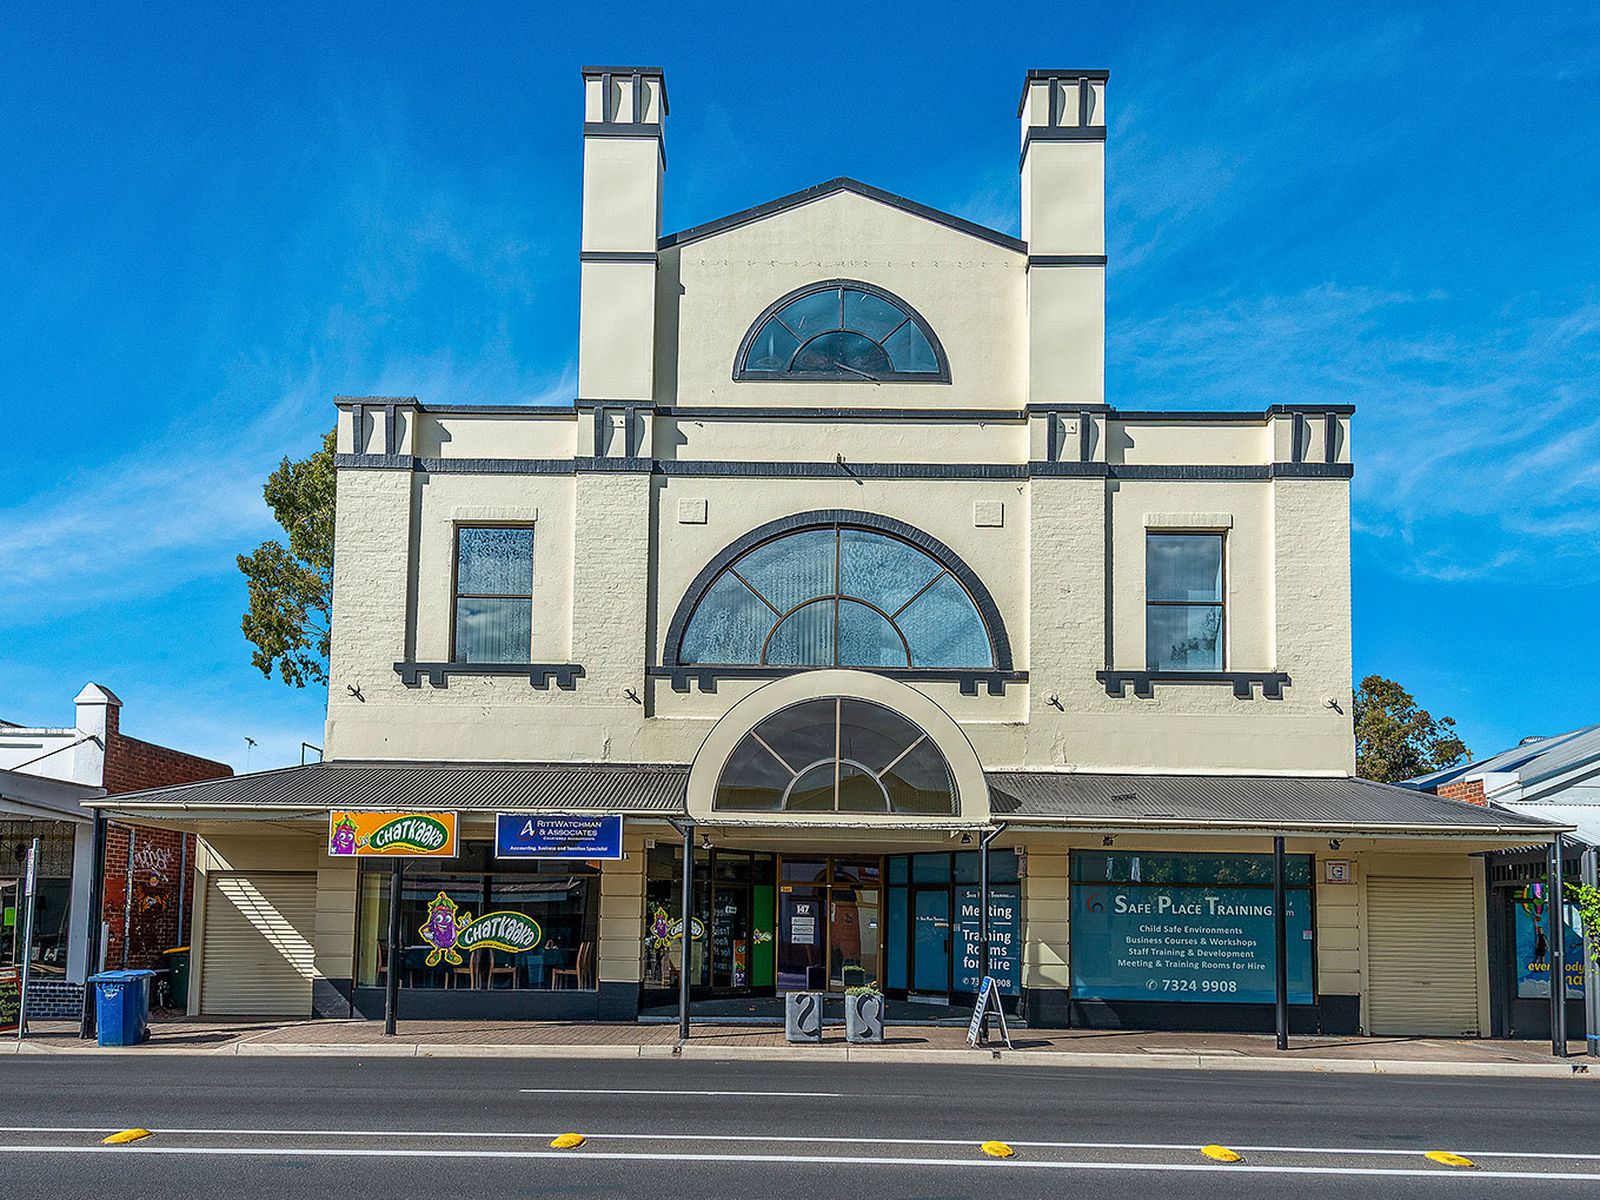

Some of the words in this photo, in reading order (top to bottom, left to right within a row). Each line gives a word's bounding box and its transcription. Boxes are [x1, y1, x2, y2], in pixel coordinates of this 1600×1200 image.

[547, 828, 598, 837] ASSOCIATES
[1115, 895, 1151, 913] SAFE
[1158, 896, 1202, 914] PLACE
[962, 905, 1012, 919] Meting
[1163, 925, 1182, 933] Safe
[1184, 926, 1243, 934] Environments
[962, 929, 1011, 944] Traning
[1126, 936, 1162, 944] Business
[1164, 937, 1198, 945] Courses
[1209, 938, 1257, 947] Workshops
[966, 943, 1008, 956] Roms
[1128, 947, 1149, 955] Staff
[1151, 948, 1185, 957] Training
[1197, 949, 1254, 958] Development
[1117, 959, 1153, 968] Meeting
[1164, 961, 1200, 969] Training
[1201, 961, 1231, 969] Rooms
[1247, 962, 1266, 970] Hire
[1162, 980, 1197, 992] 7324
[1201, 981, 1237, 993] 9908
